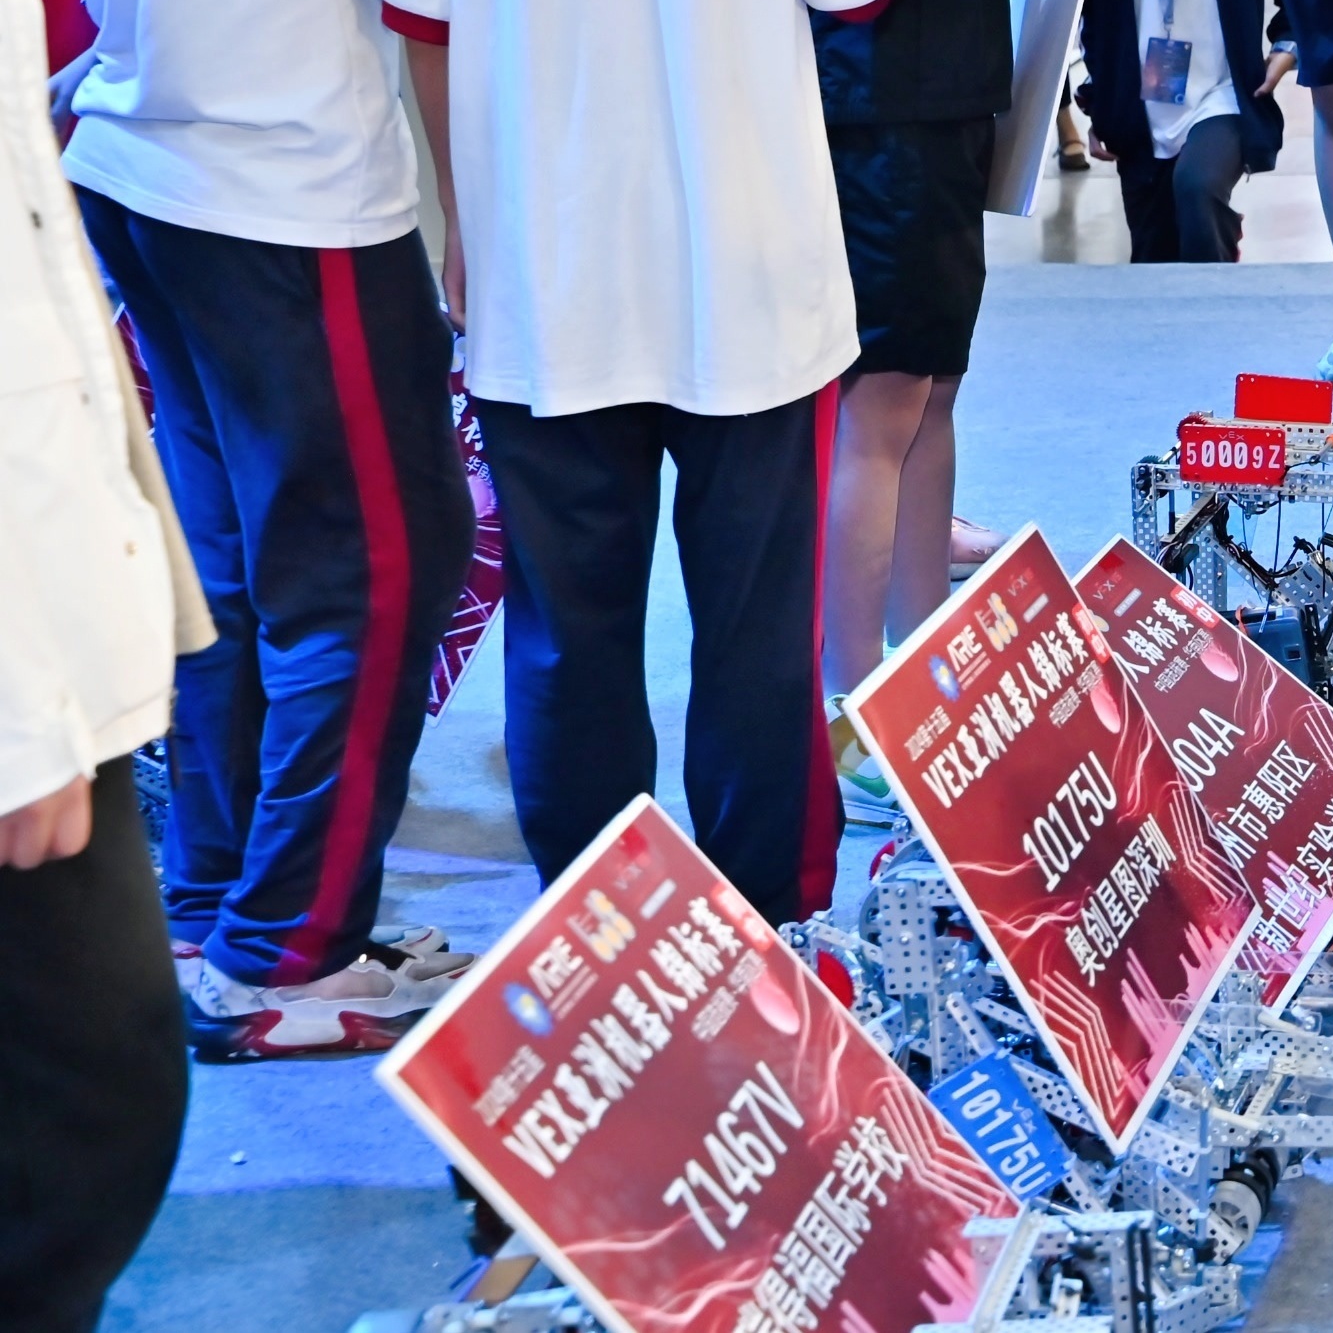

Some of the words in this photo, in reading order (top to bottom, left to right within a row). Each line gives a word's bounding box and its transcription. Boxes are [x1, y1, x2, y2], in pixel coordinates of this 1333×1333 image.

[1186, 440, 1281, 469] 50009Z
[1218, 431, 1245, 441] VEX
[921, 611, 1089, 809] VEX亚洲机器人锦标赛
[1022, 750, 1117, 893] 10175U
[1065, 812, 1177, 988] 奥创星图深圳
[501, 896, 743, 1178] VEX亚洲机器人锦标赛
[662, 1060, 805, 1251] 71467V
[951, 1070, 1053, 1196] 10175U
